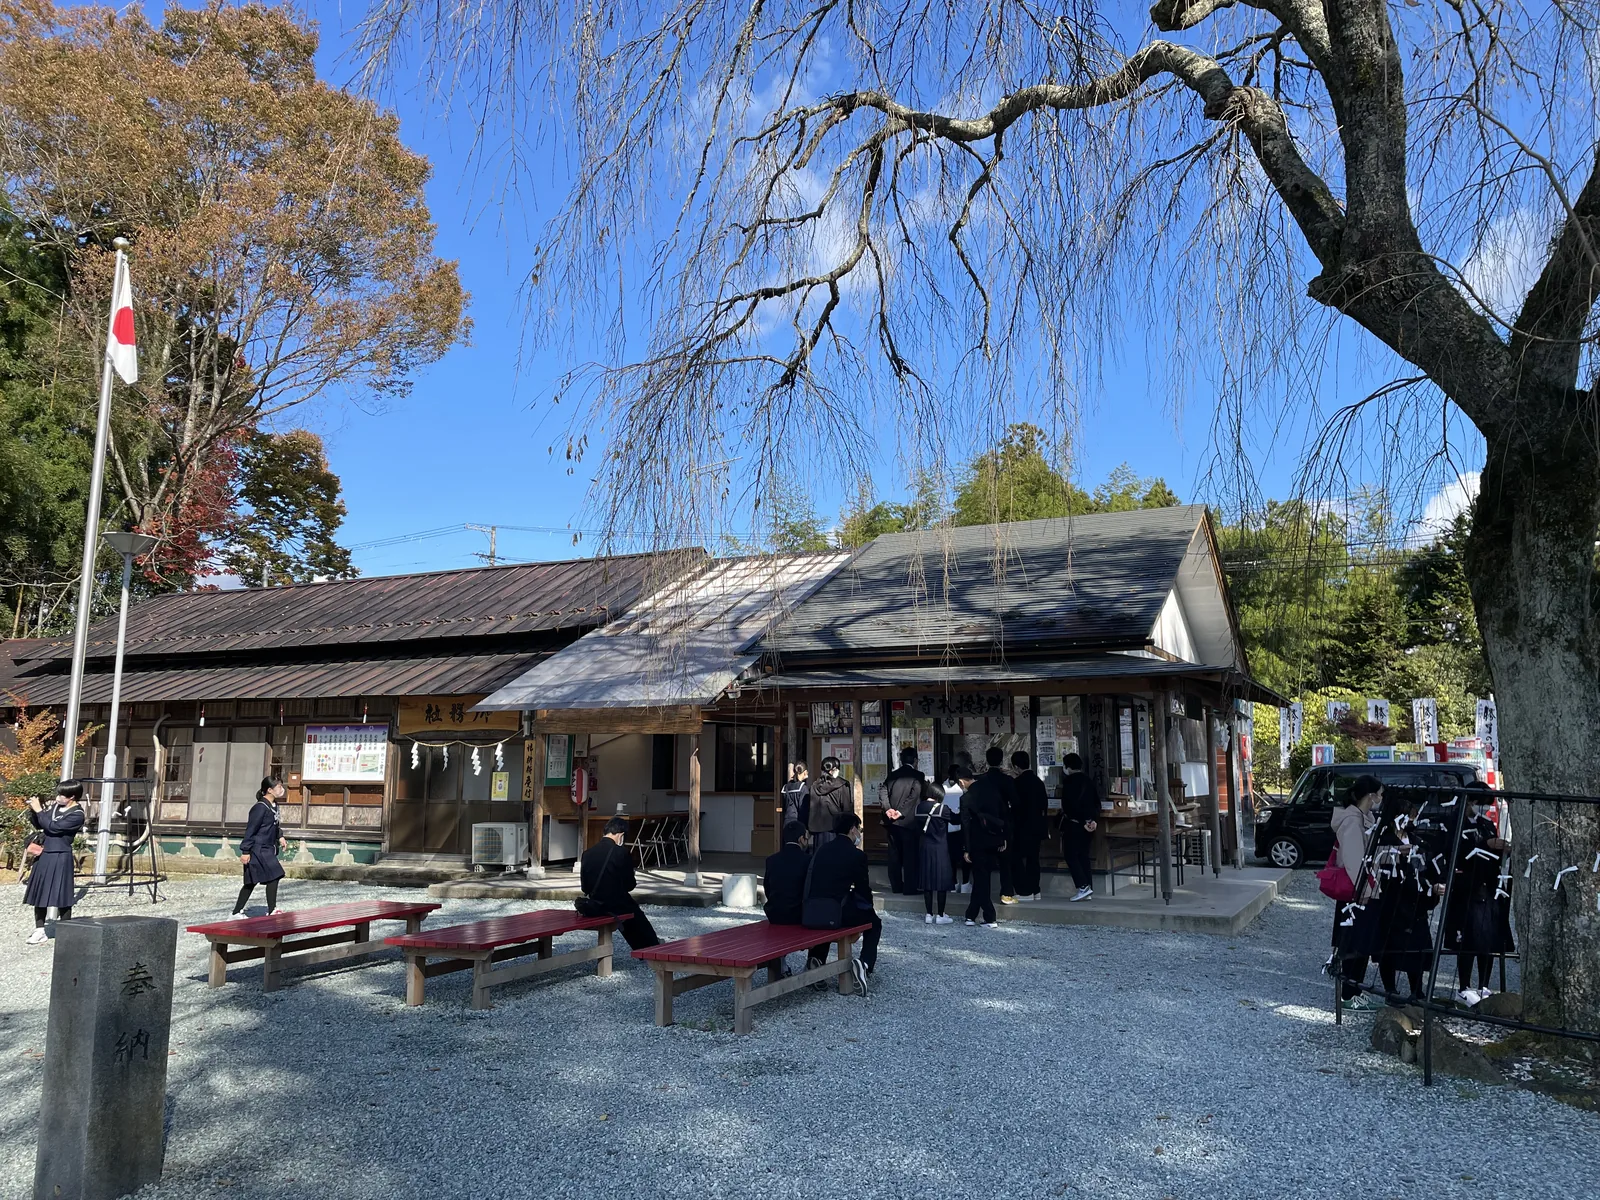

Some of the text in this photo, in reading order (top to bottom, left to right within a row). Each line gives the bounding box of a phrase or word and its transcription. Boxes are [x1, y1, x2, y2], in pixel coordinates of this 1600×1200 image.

[918, 694, 1006, 715] 守札授与所
[114, 961, 157, 1064] 奉納
